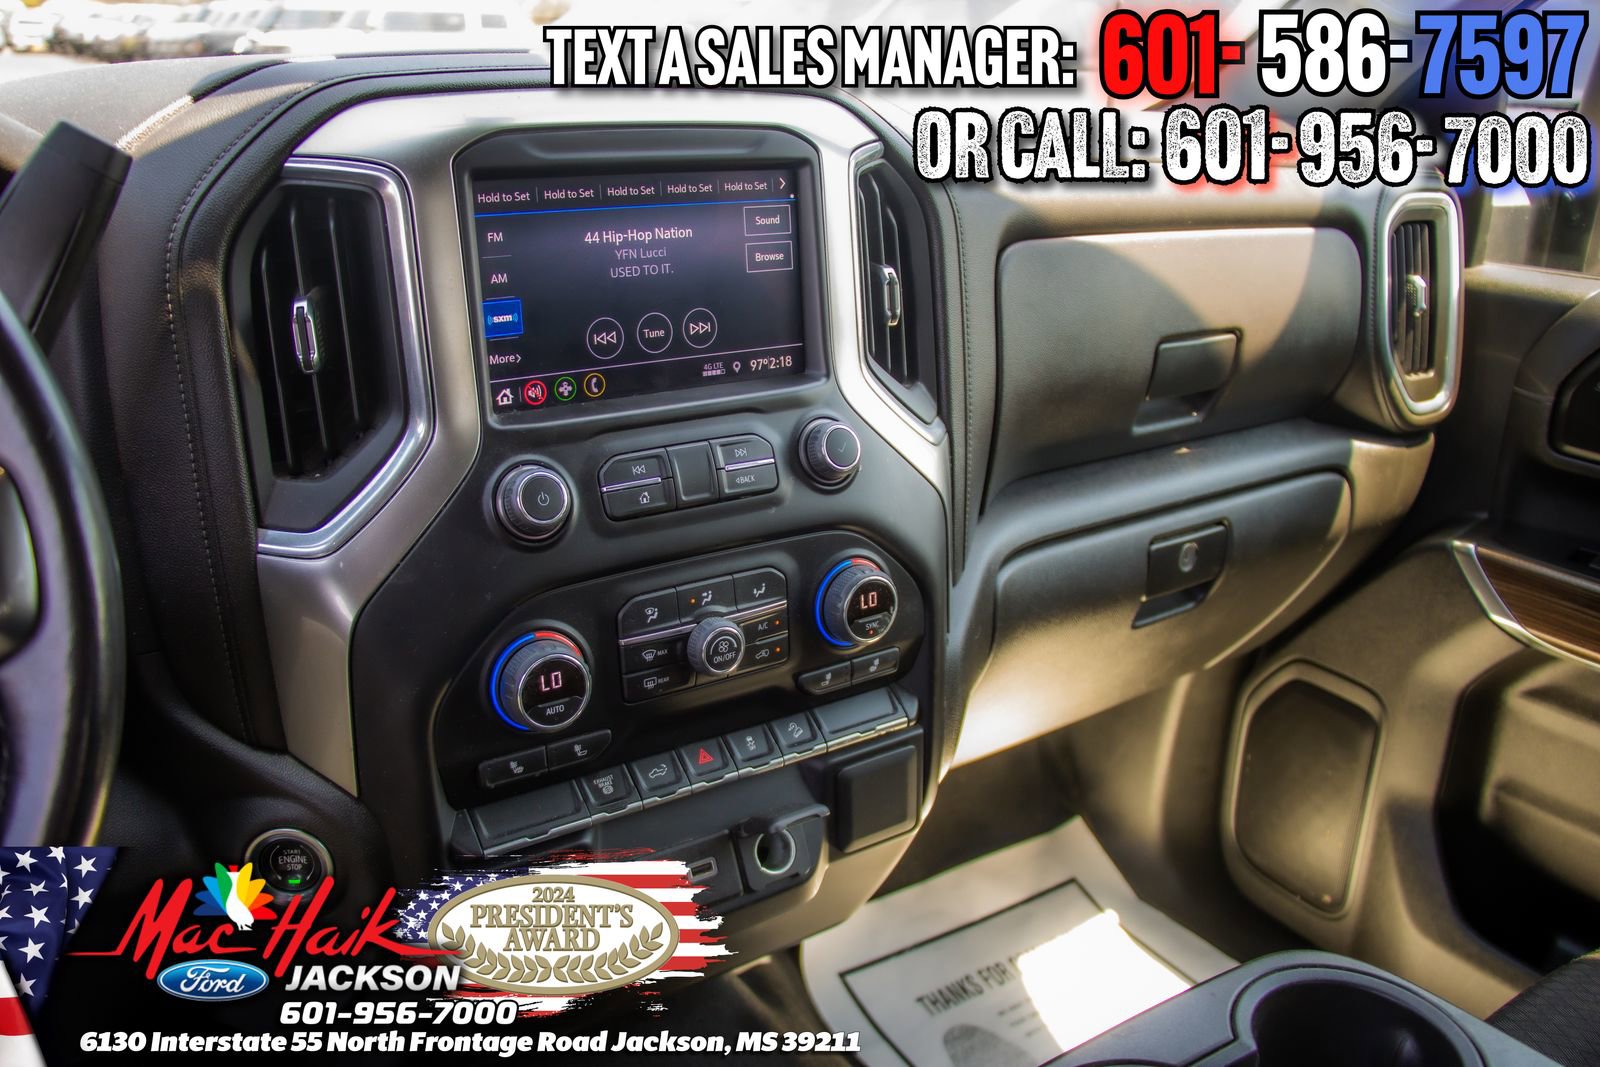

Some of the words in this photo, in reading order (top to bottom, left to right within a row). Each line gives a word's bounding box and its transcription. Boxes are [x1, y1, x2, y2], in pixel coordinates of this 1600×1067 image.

[668, 184, 687, 194] Hold
[699, 184, 712, 192] Set
[724, 182, 742, 190] Hold
[754, 180, 768, 190] Set
[544, 190, 566, 200] Hold
[579, 188, 594, 198] Set
[608, 187, 628, 196] Hold
[640, 186, 655, 195] Set
[477, 194, 500, 204] Hold
[502, 194, 512, 202] to
[514, 192, 530, 201] Set
[756, 214, 780, 224] Sound
[488, 232, 504, 242] FM
[584, 232, 600, 244] 44
[603, 228, 652, 246] Hip-Hop
[655, 227, 692, 240] Nation
[616, 248, 637, 260] YFN
[640, 247, 666, 258] Lucci
[756, 252, 784, 262] Browse
[610, 266, 640, 278] USED
[643, 264, 658, 275] TO
[662, 264, 674, 274] IT.
[491, 273, 508, 284] AM
[493, 314, 512, 323] sxm
[642, 329, 664, 338] Tune
[489, 354, 516, 364] More
[770, 356, 792, 369] 2:18
[740, 475, 755, 484] BACK
[714, 652, 736, 664] ON/OFF
[546, 704, 565, 716] AUTO
[278, 854, 307, 864] ENGINE
[916, 973, 984, 1016] THANKS
